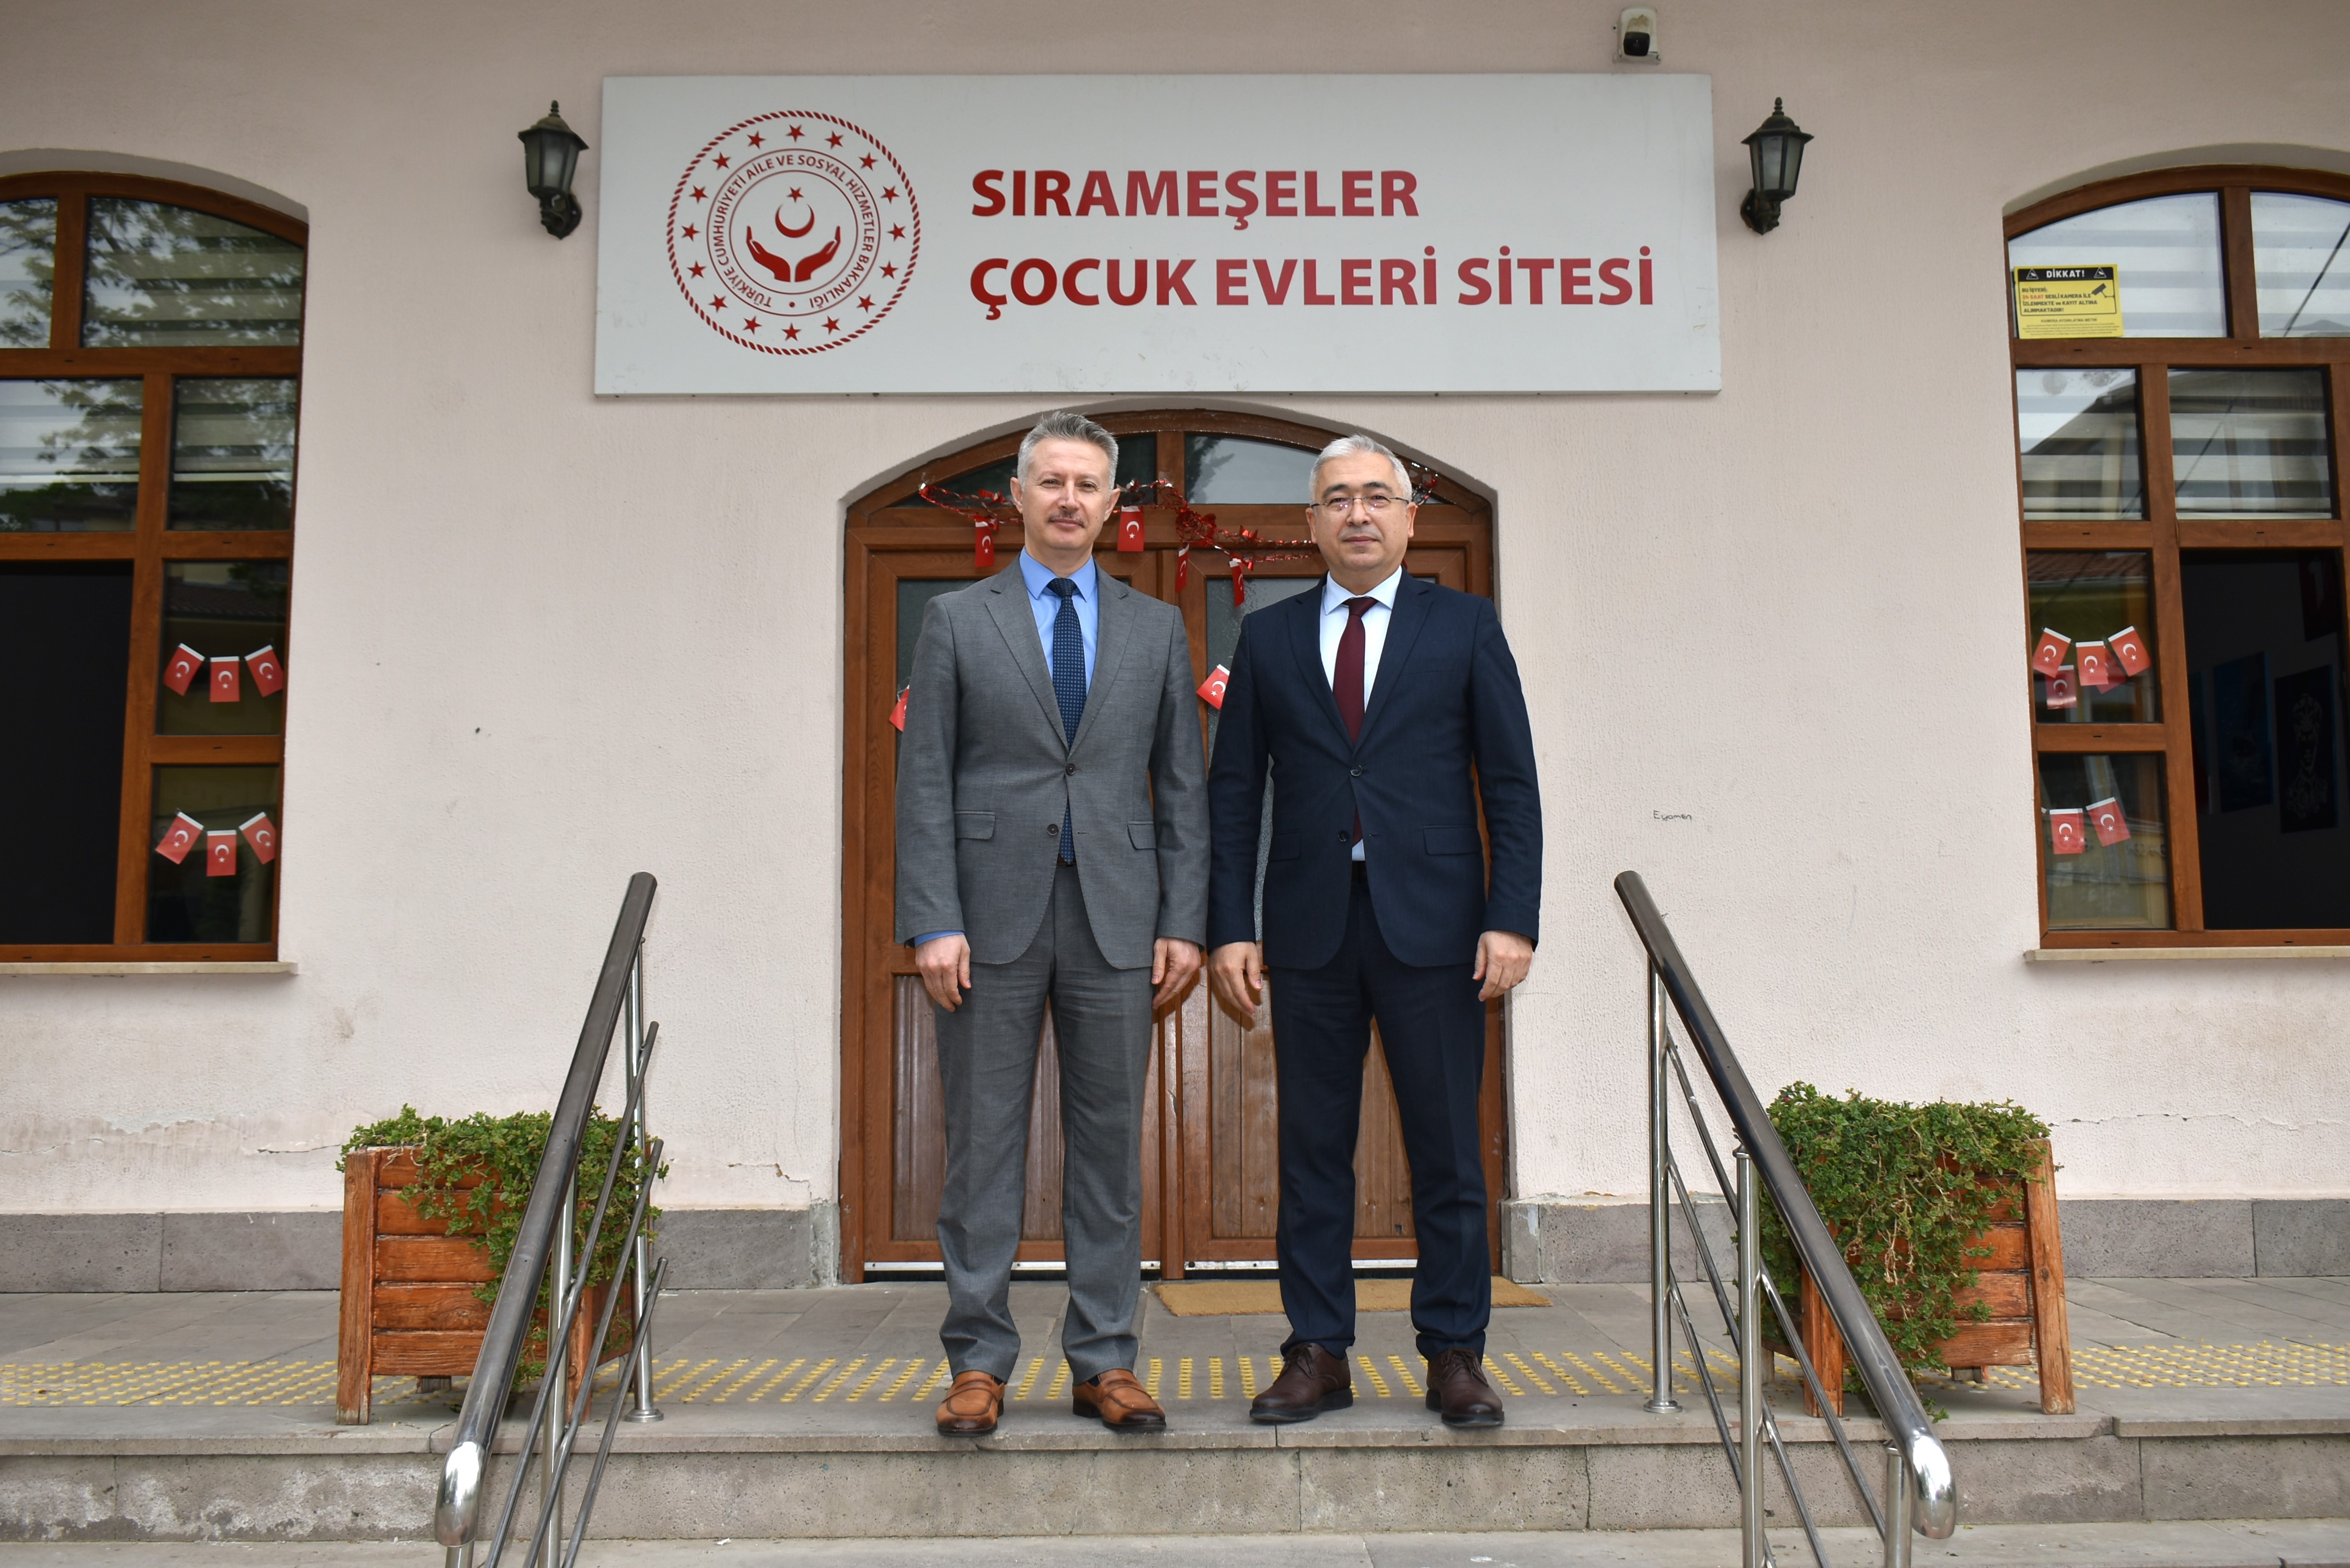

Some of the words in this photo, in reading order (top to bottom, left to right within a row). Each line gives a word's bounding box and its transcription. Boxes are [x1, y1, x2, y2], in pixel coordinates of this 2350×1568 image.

[746, 158, 774, 180] AİLE
[776, 155, 794, 166] VE
[798, 156, 846, 182] SOSYAL
[713, 174, 746, 266] CUMHURİYETİ
[845, 179, 874, 251] HİZMETLER
[973, 170, 1419, 230] SIRAMEŞELER
[723, 267, 771, 308] TÜRKİYE
[809, 255, 869, 309] BAKANLIĞI
[971, 258, 1196, 320] ÇOCUK
[1217, 246, 1437, 305] EVLERİ
[1459, 246, 1653, 305] SİTESİ
[2046, 269, 2084, 279] DİKKAT!
